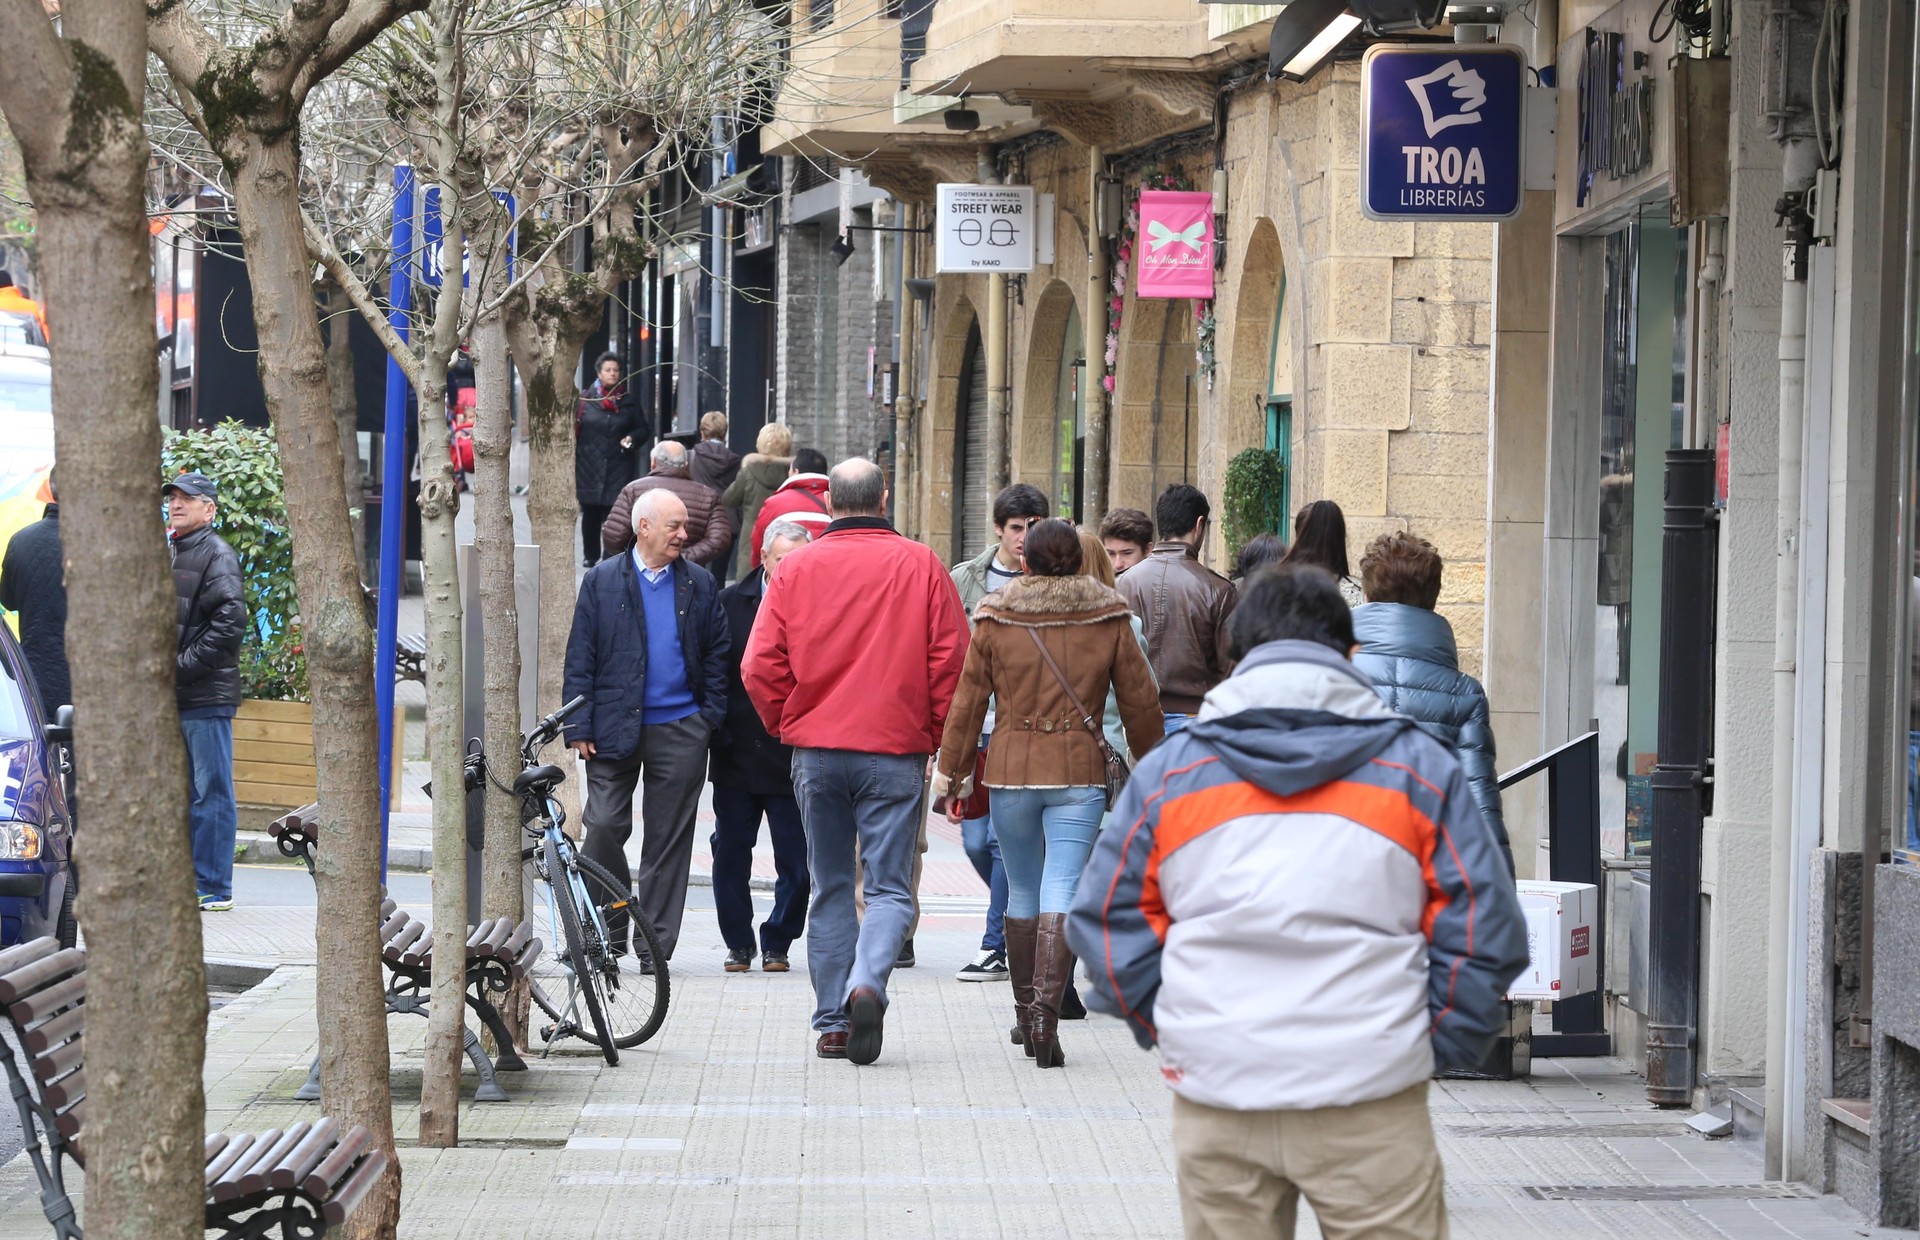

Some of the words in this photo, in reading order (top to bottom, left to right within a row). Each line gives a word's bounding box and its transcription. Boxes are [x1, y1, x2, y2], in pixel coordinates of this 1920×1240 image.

[1402, 146, 1486, 185] TROA
[1400, 185, 1485, 207] LIBRERÍAS
[951, 203, 987, 214] STREET
[990, 204, 1022, 214] WEAR
[1145, 255, 1158, 264] Oh
[1159, 254, 1178, 264] Mon
[1180, 252, 1207, 265] Dieu!
